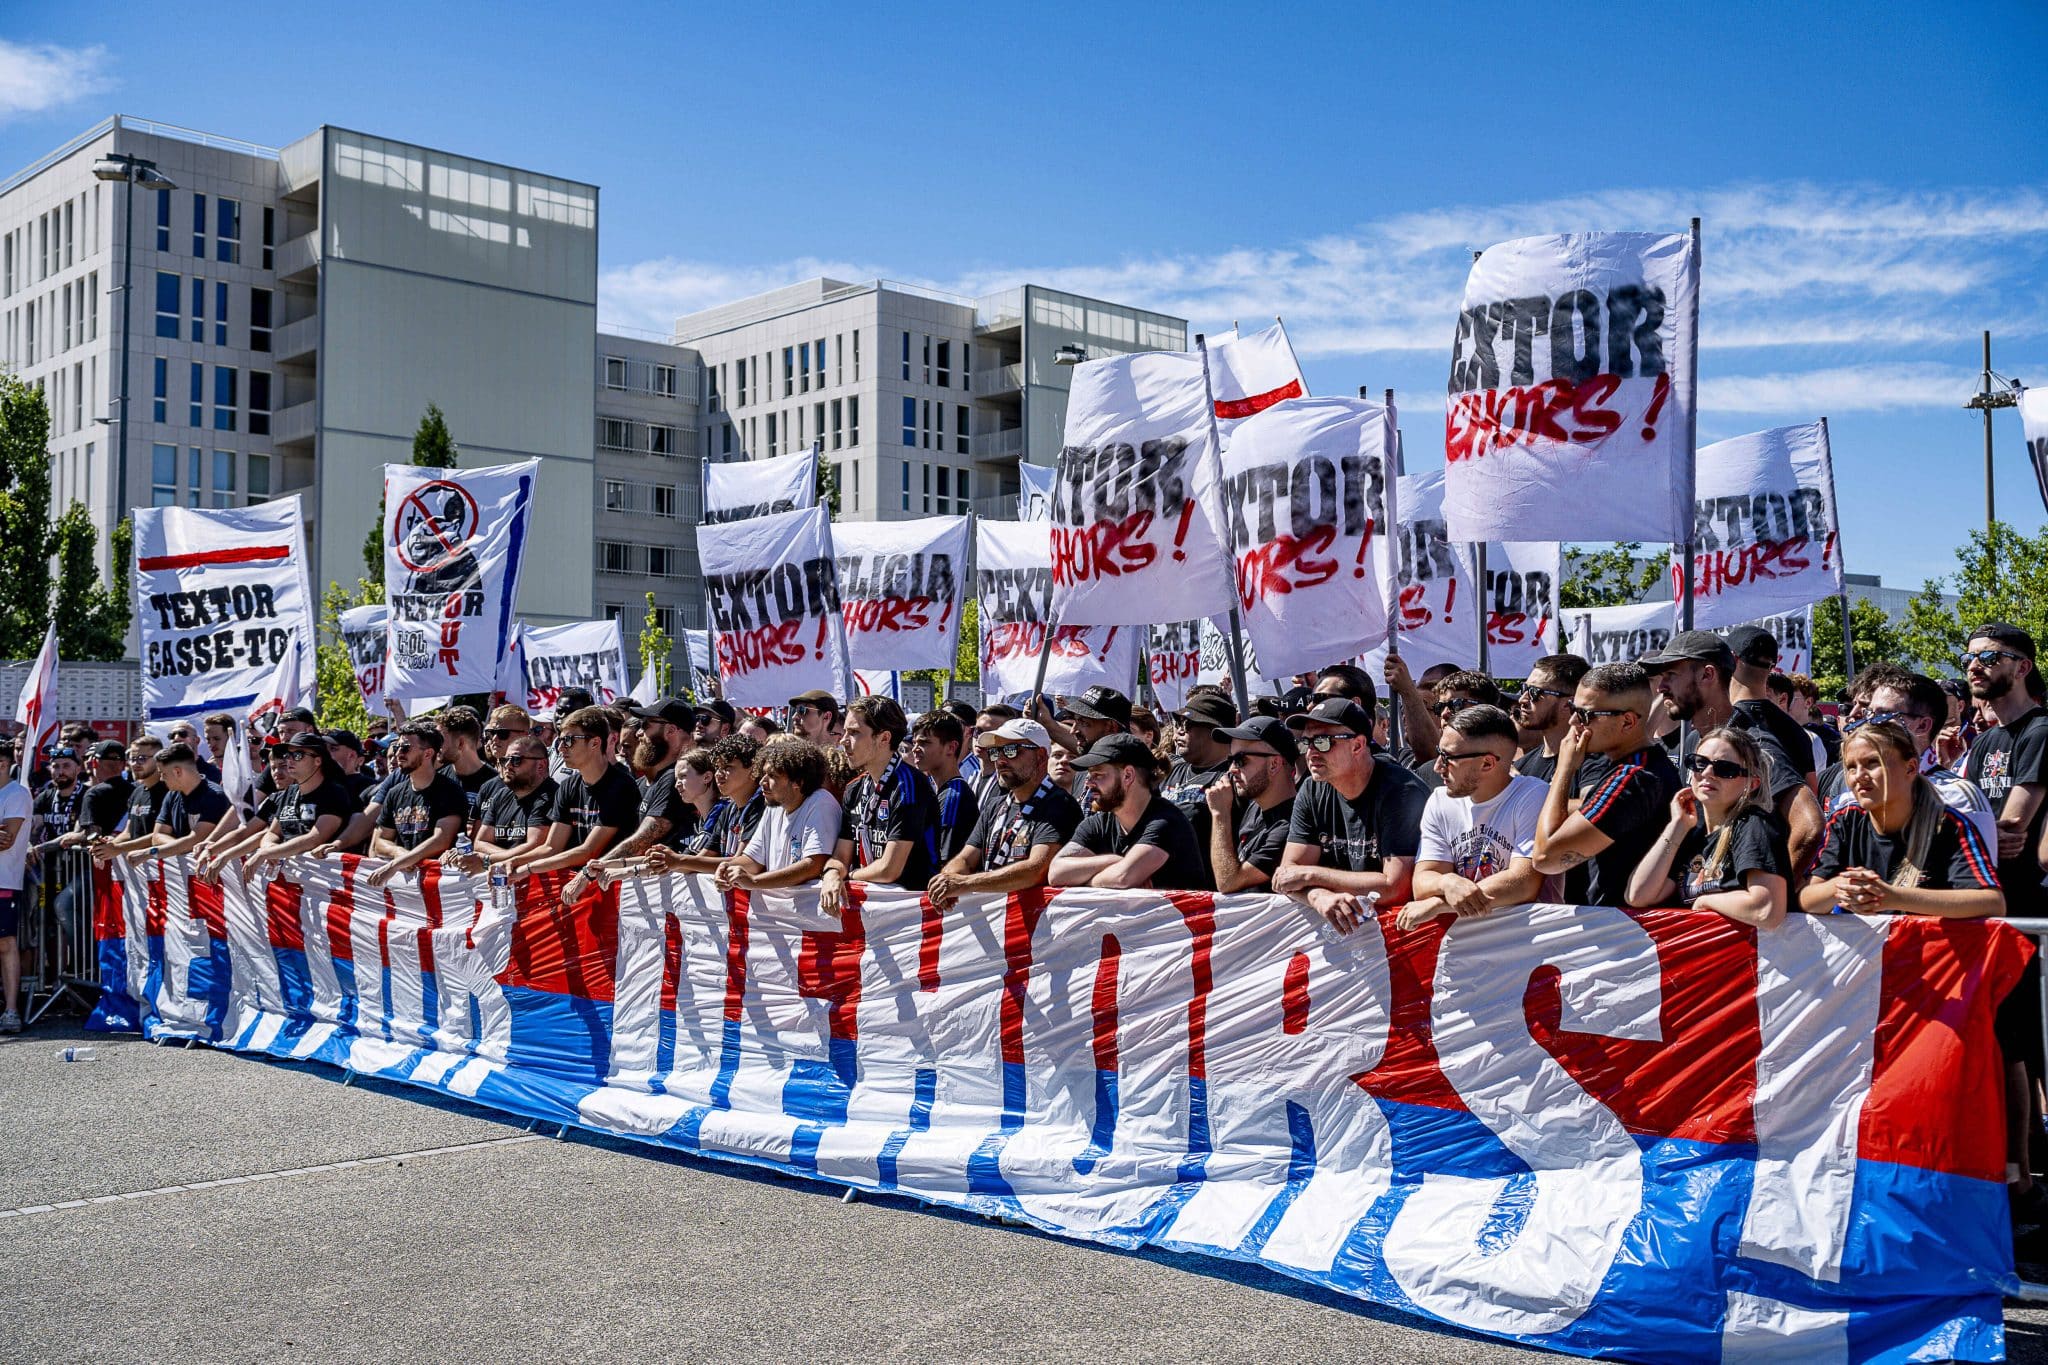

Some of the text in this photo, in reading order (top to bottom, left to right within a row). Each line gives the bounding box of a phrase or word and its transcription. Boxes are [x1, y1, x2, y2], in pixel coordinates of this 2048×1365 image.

[1223, 455, 1385, 553] XTOR
[150, 584, 278, 630] TEXTOR
[392, 591, 485, 622] TEXTOR
[705, 557, 841, 632] EXTOR
[149, 625, 294, 680] CASSE-TO
[577, 870, 1645, 1338] DEHORS
